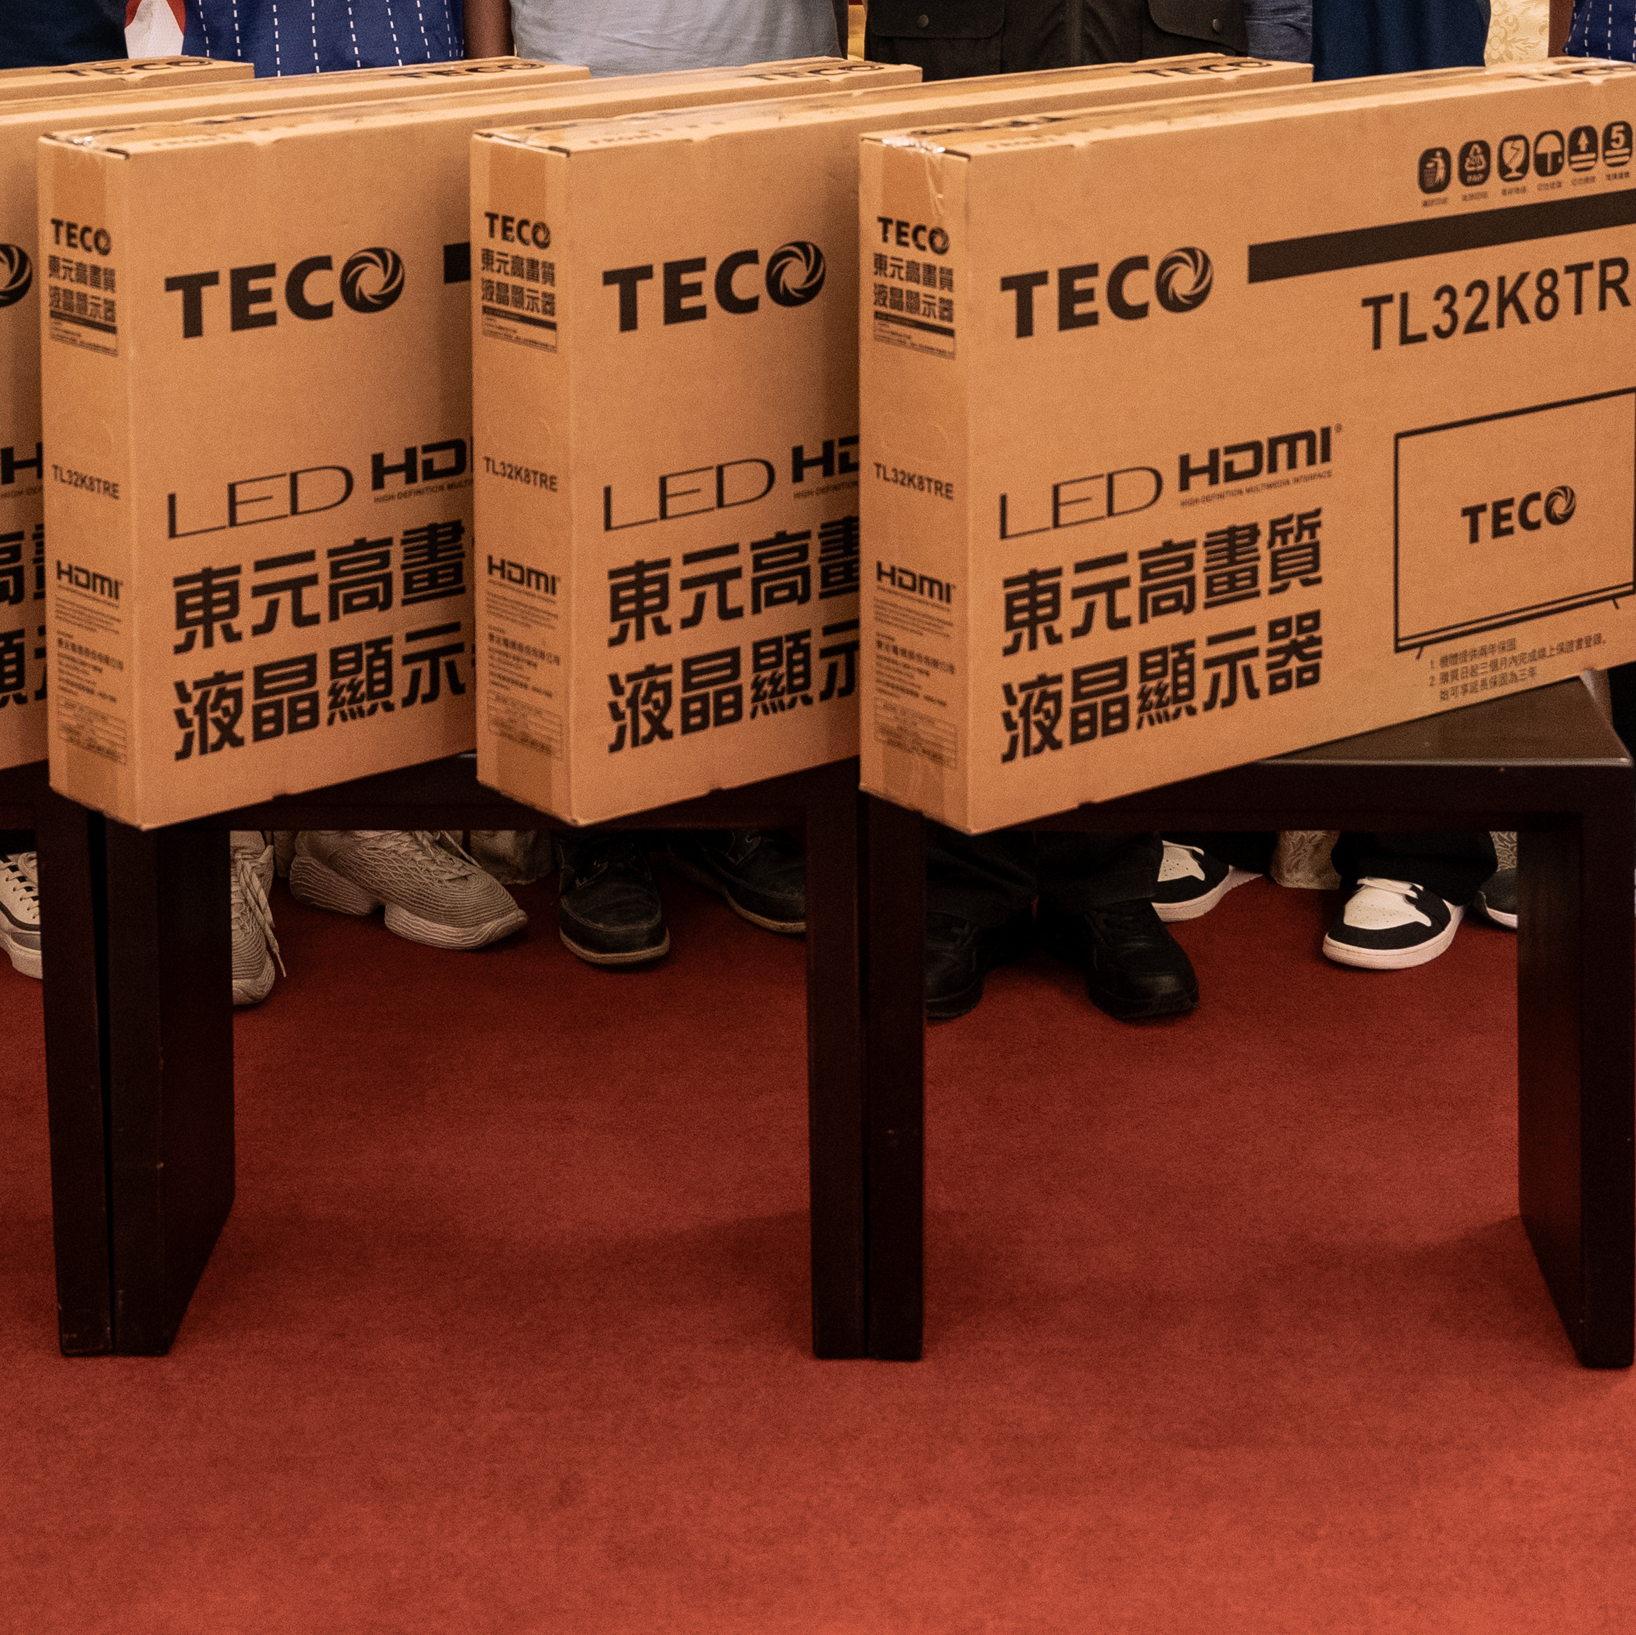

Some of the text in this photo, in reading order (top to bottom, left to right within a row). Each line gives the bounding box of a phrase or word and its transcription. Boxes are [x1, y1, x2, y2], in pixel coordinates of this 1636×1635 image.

[50, 218, 111, 256] TECO
[484, 211, 551, 250] TECO
[877, 216, 950, 256] TECO
[165, 246, 405, 340] TECO
[602, 240, 826, 333] TECO
[1000, 245, 1214, 339] TECO
[51, 463, 120, 501] TL32K8TRE
[167, 436, 473, 539] LED HD
[483, 456, 559, 493] TL32K8TRE
[603, 457, 776, 533] LED
[873, 462, 954, 501] TL32K8TRE
[999, 426, 1333, 540] LED HDMI
[1461, 485, 1576, 545] TECO
[56, 560, 120, 600] HDMI
[171, 519, 466, 656] 東元高畫
[487, 554, 556, 596] HDMI
[876, 561, 951, 604] HDMI
[1002, 507, 1323, 658] 東元高畫質
[1000, 609, 1323, 763] 液晶顯示器
